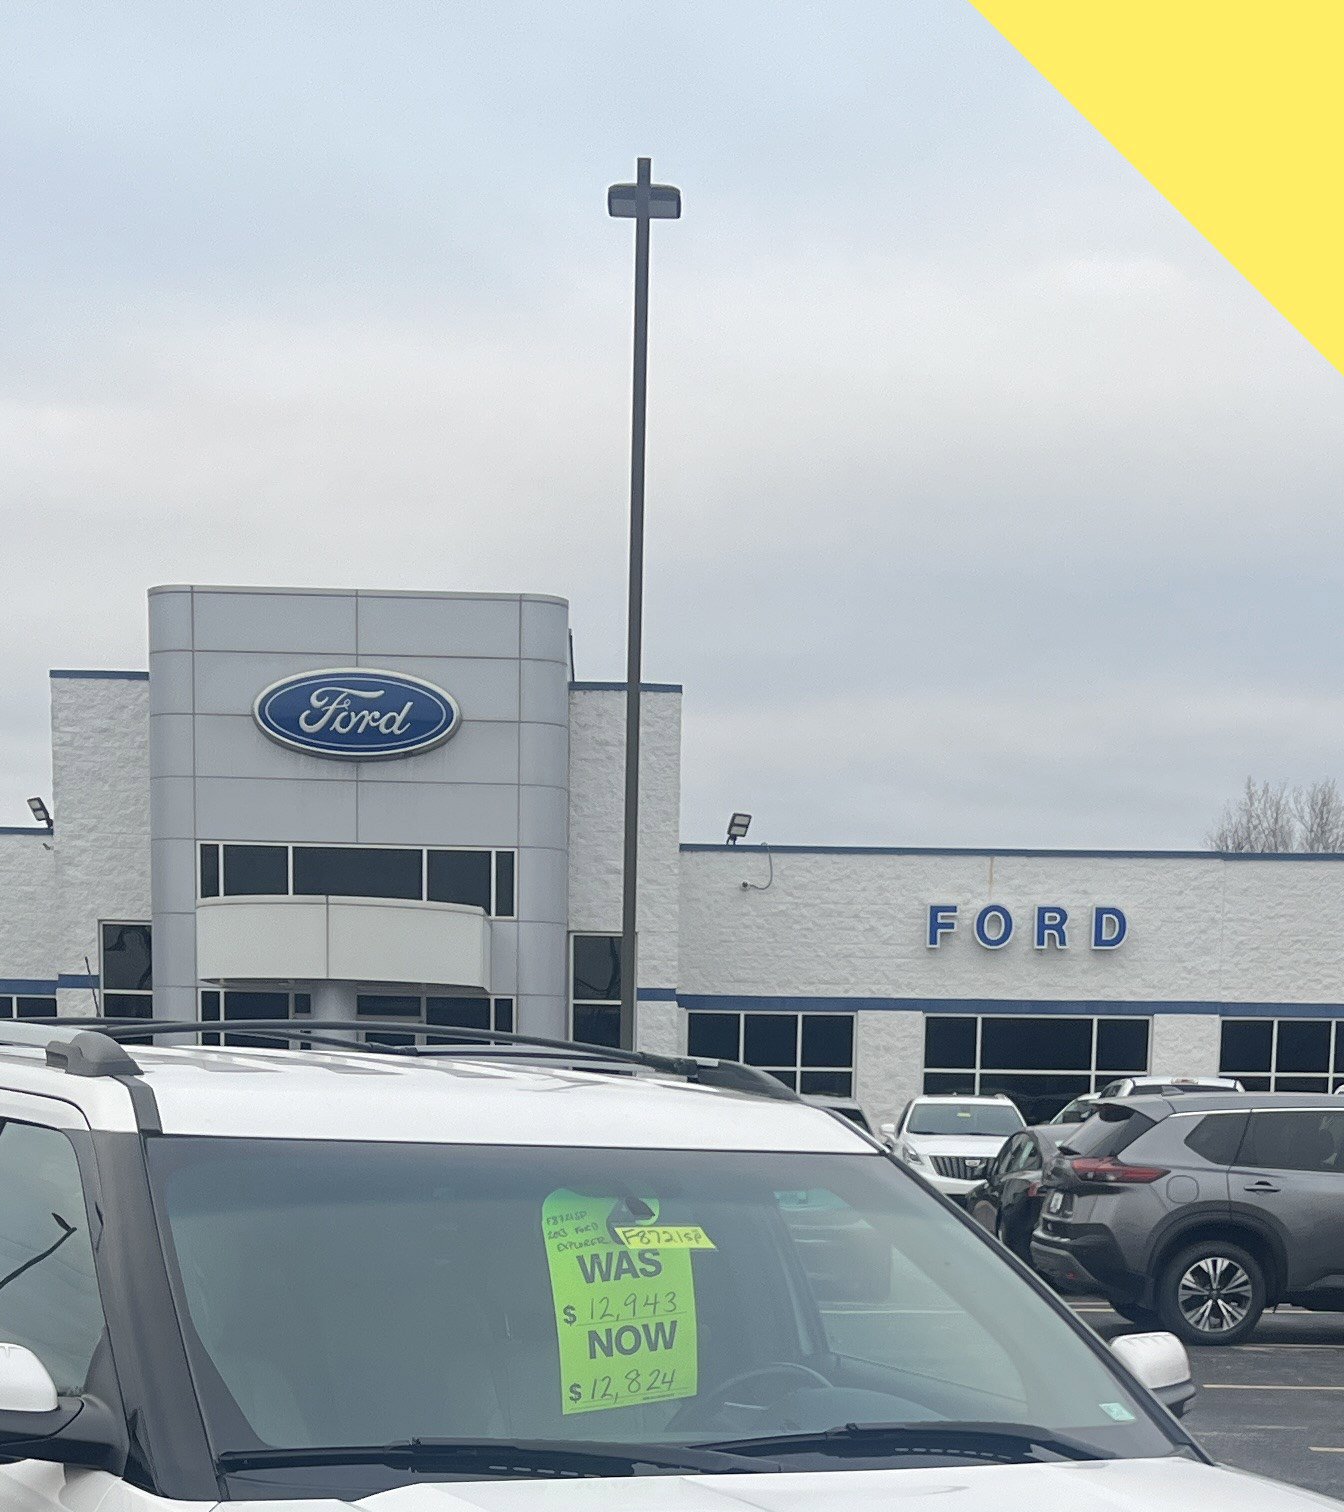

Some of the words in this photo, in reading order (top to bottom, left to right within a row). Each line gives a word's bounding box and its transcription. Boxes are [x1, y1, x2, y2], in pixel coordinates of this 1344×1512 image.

[299, 686, 414, 735] Ford
[928, 905, 1129, 949] FORD
[576, 1249, 662, 1284] WAS
[590, 1291, 677, 1321] 12,943
[587, 1320, 678, 1360] NOW
[591, 1368, 675, 1404] 12,824
